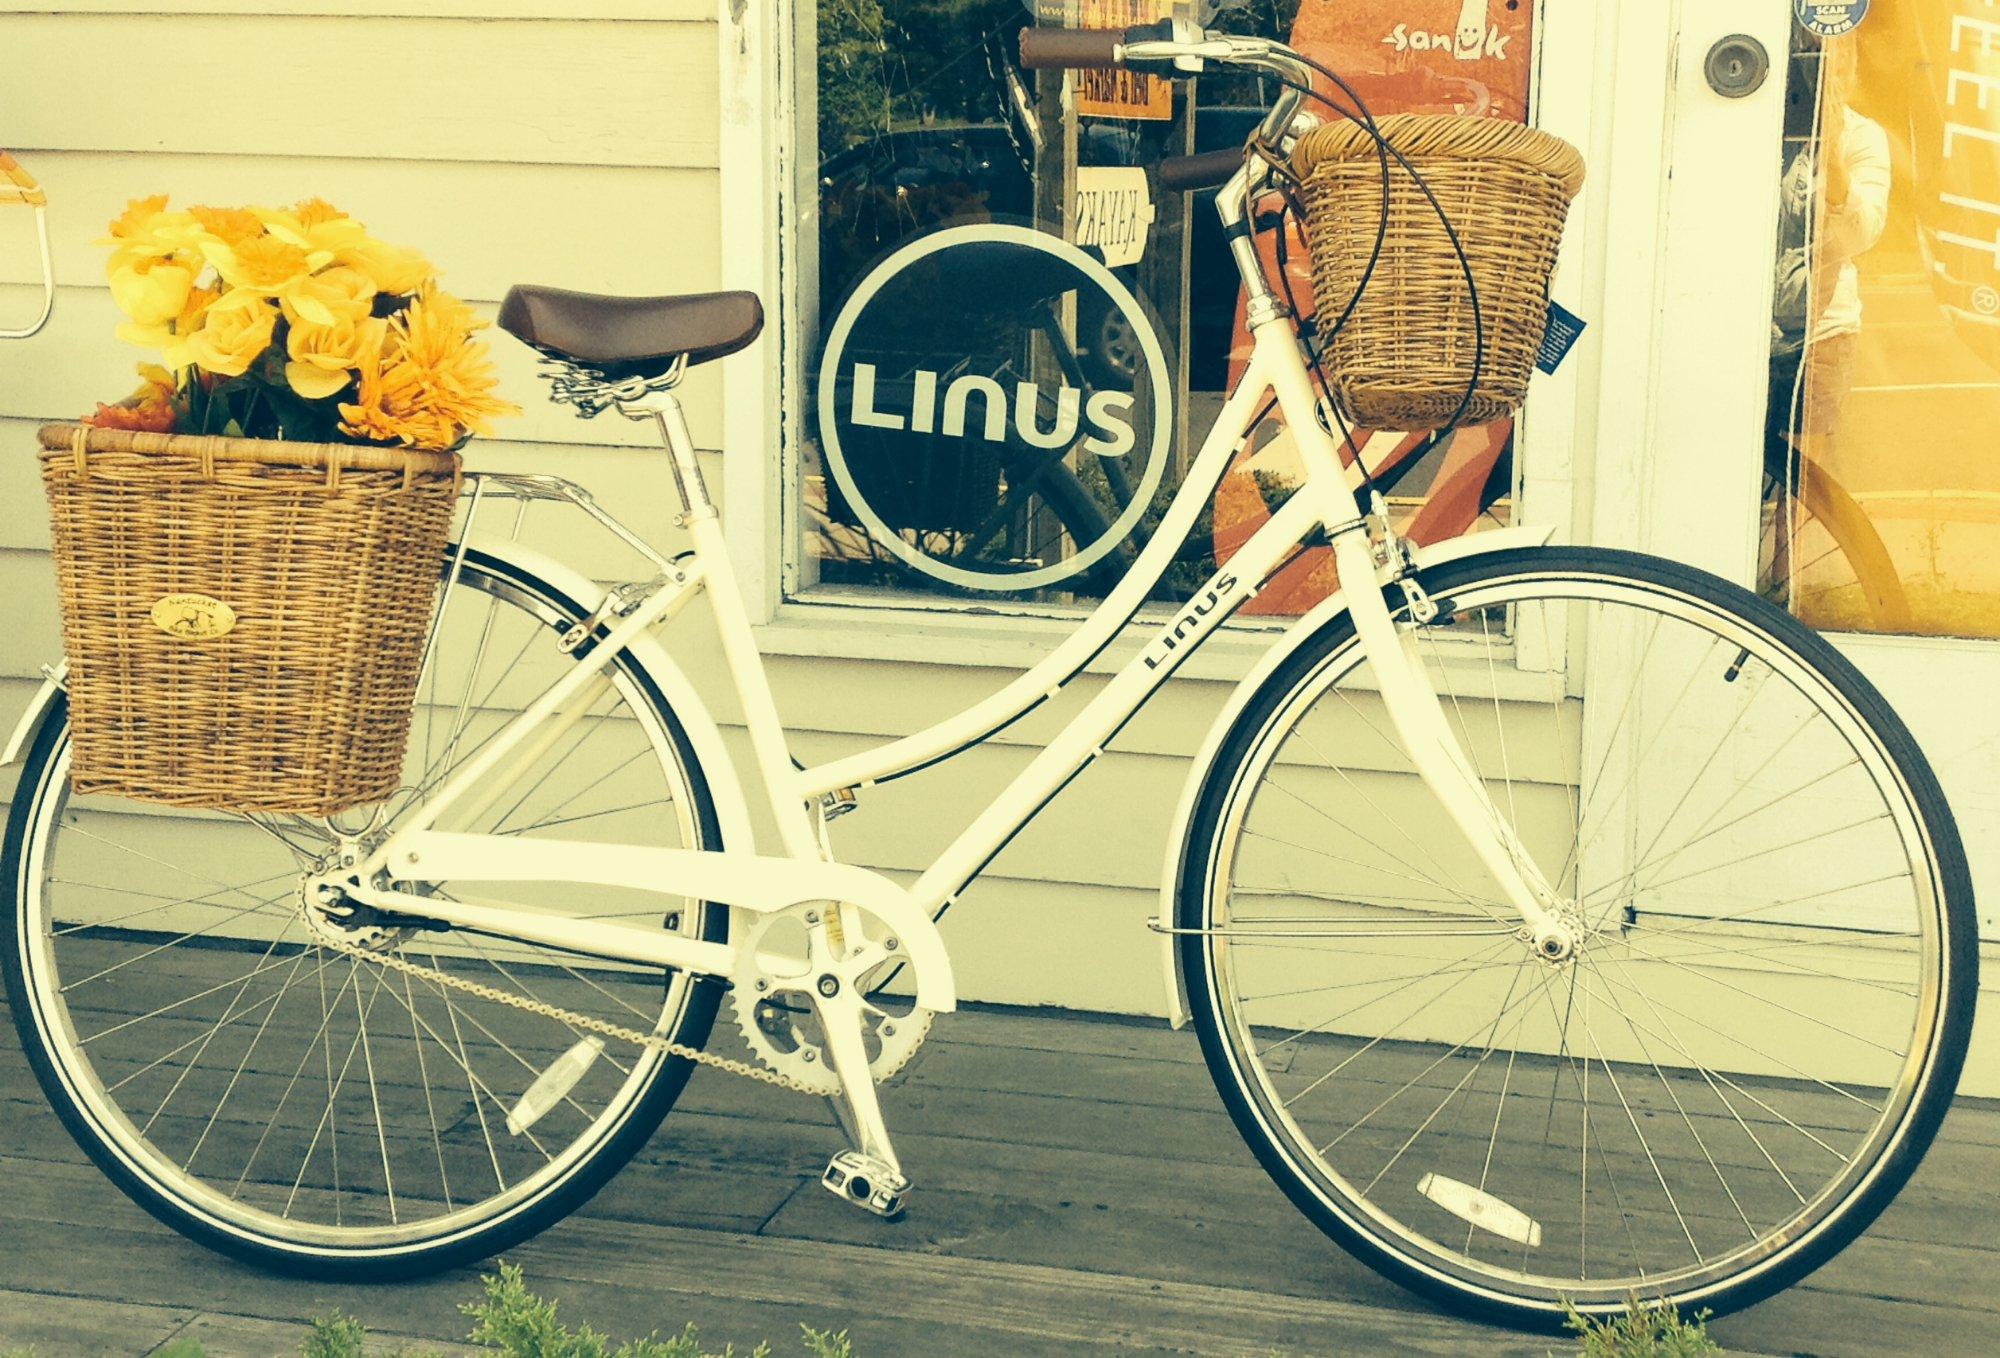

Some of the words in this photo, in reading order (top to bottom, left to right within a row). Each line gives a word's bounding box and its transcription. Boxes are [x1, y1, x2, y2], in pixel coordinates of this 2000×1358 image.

[1808, 19, 1854, 35] ALARM
[1816, 5, 1846, 15] SCAN
[1942, 0, 2000, 159] EEL
[850, 362, 1136, 457] LINUS
[1144, 572, 1238, 670] LINUS
